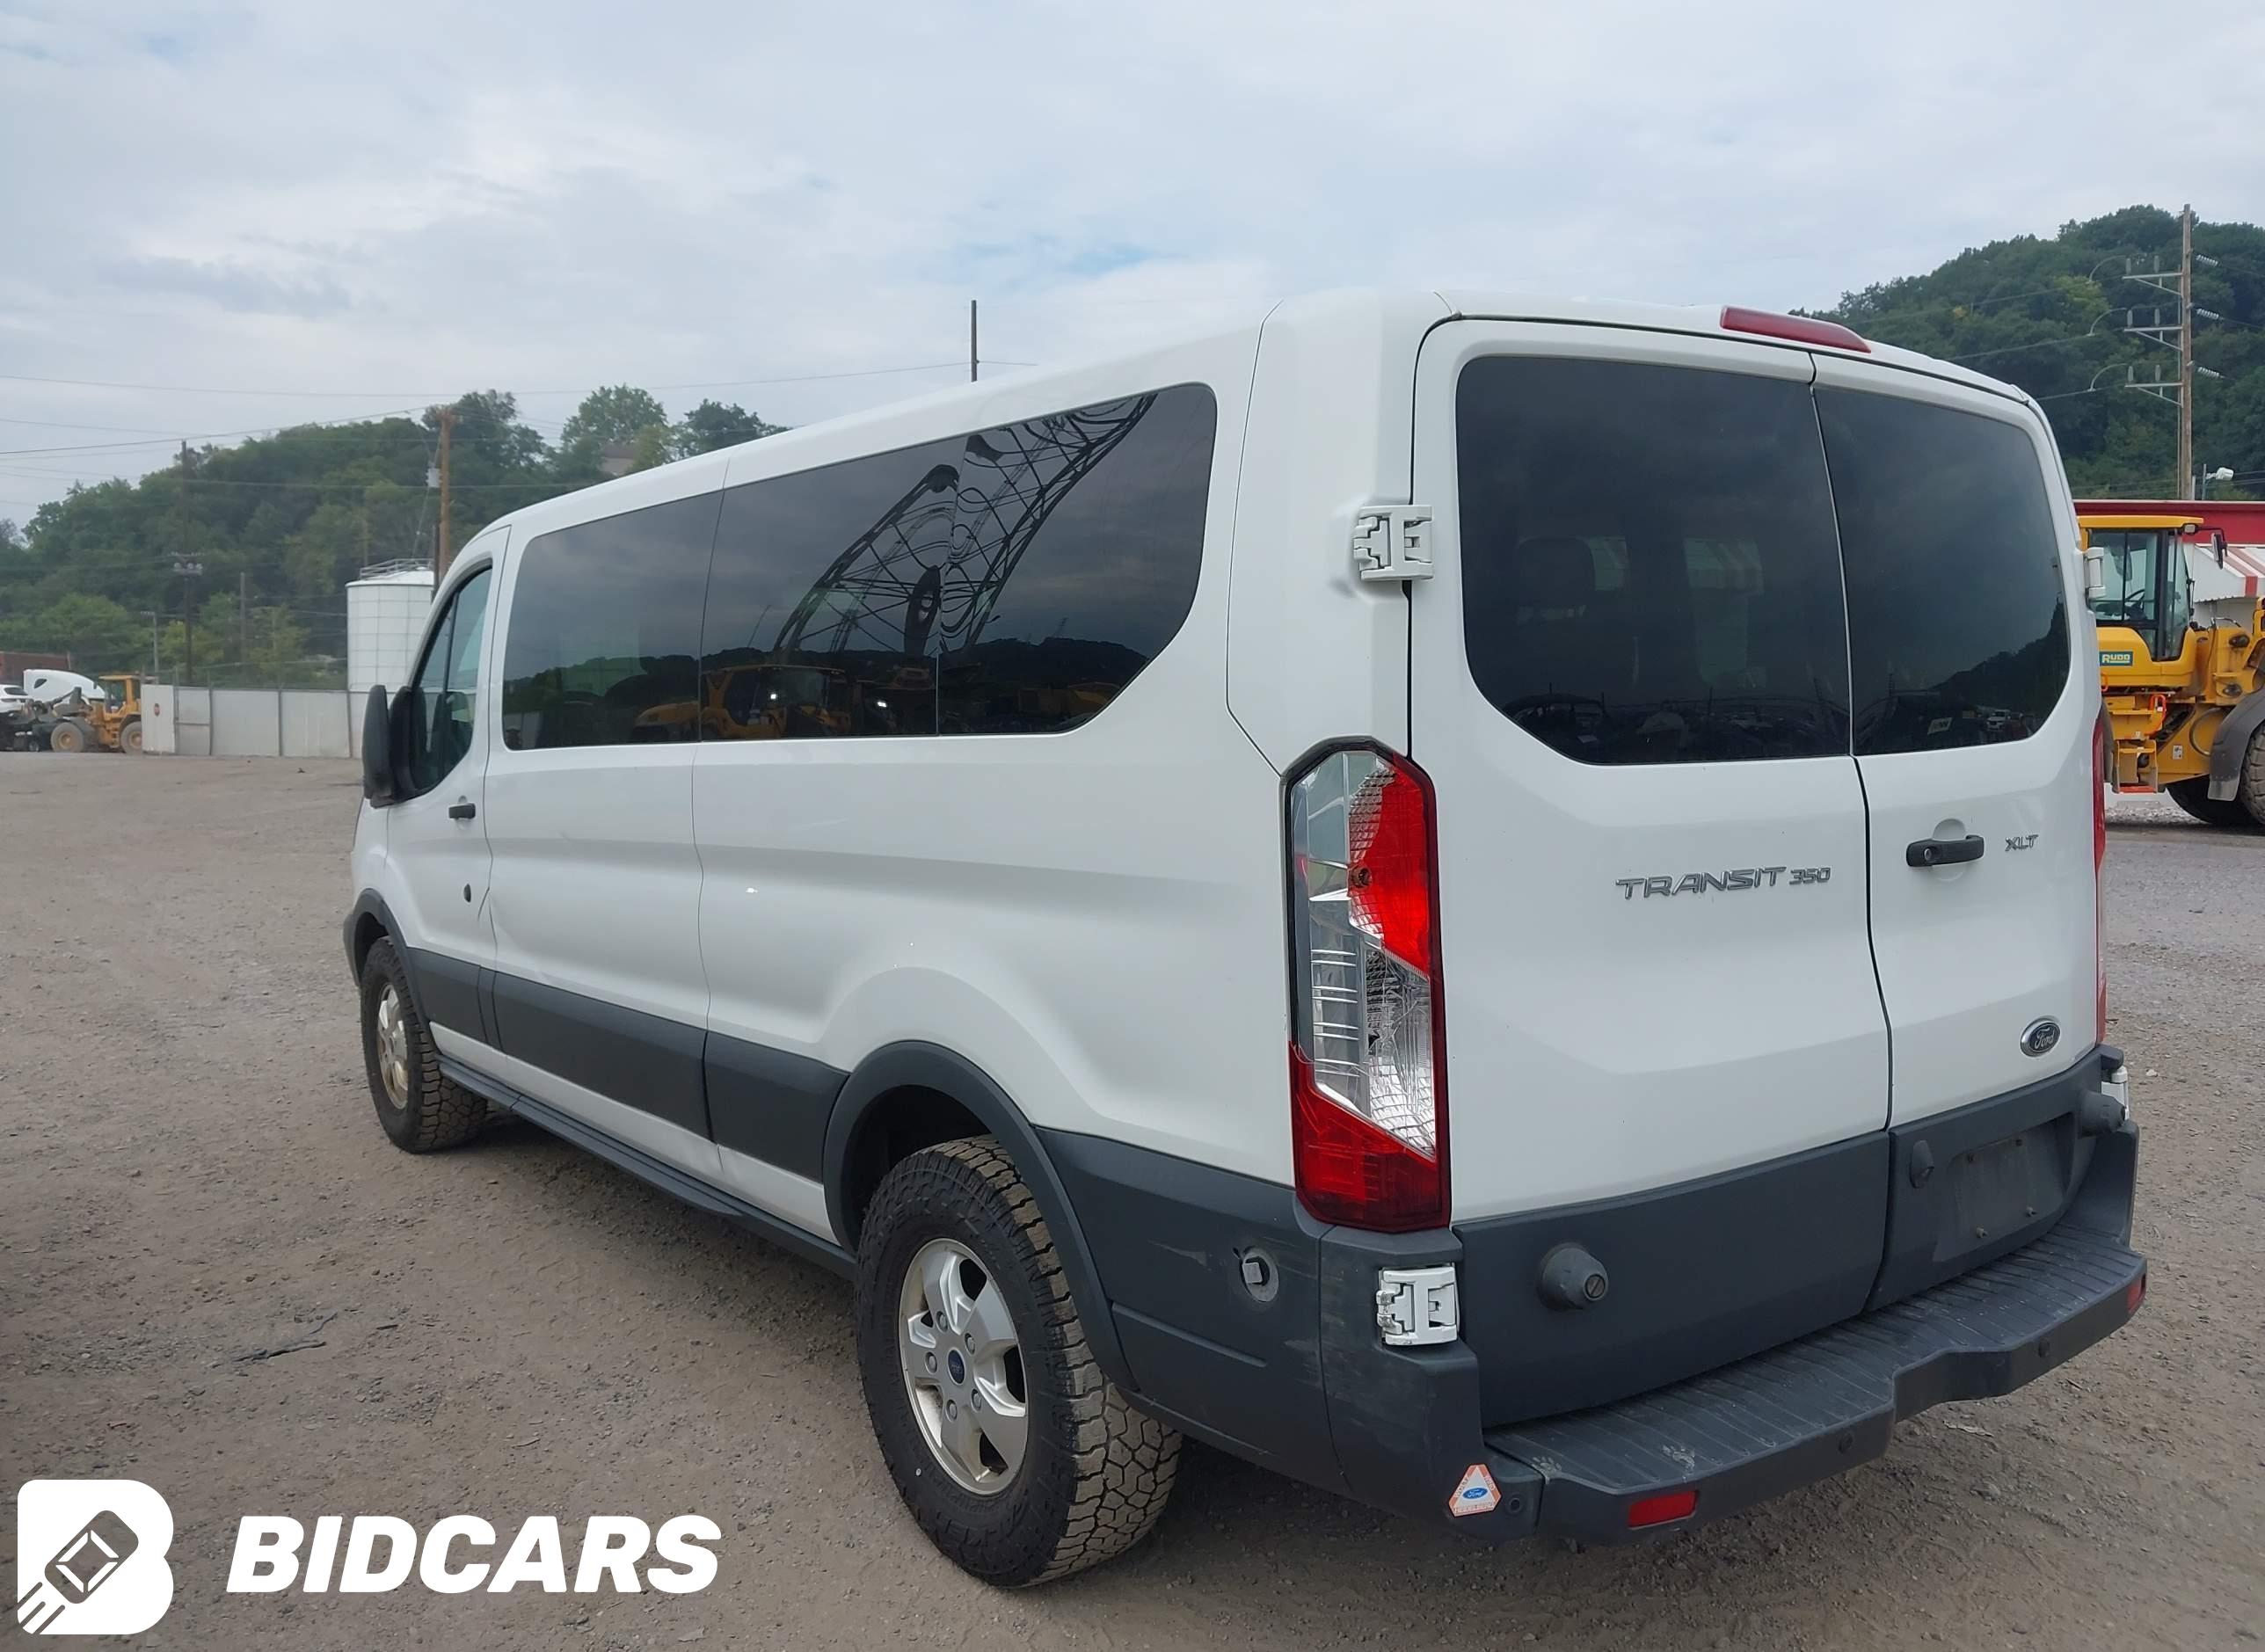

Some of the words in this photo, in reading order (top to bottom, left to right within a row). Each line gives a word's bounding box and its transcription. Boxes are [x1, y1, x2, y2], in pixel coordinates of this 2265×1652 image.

[2005, 834, 2039, 852] XLT
[1616, 866, 1788, 900] TRANSIT
[1789, 867, 1832, 885] 350
